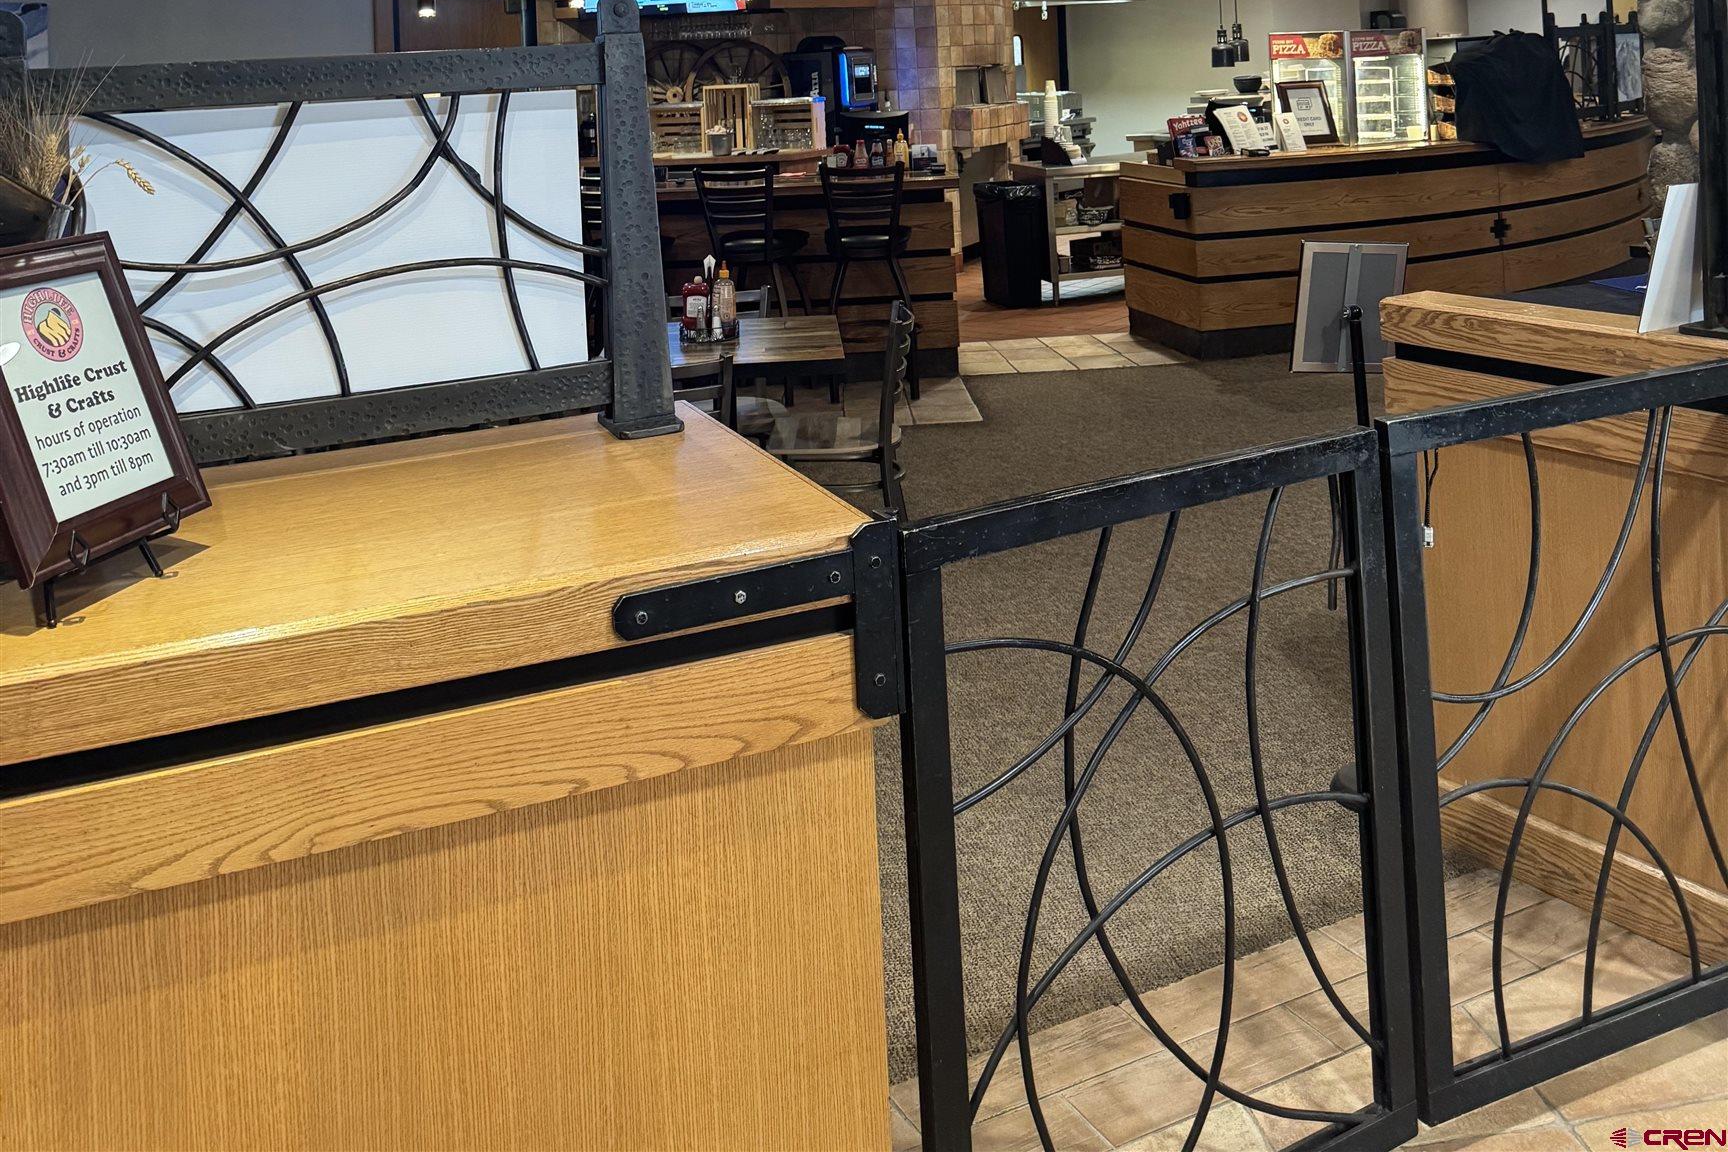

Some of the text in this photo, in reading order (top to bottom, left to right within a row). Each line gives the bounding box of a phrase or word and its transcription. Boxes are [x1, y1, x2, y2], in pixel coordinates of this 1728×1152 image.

[1272, 44, 1306, 55] PIZZA
[1352, 41, 1387, 52] PIZZA
[1173, 117, 1203, 131] Yahtzee
[33, 338, 56, 356] CRUST
[66, 328, 80, 354] CRAFTS
[14, 360, 128, 403] Highlife Crust
[47, 389, 115, 419] & Crafts
[35, 406, 142, 450] hours of operation
[42, 428, 152, 478] 7:30am till 10:30am
[58, 452, 154, 496] and 3pm till 8pm
